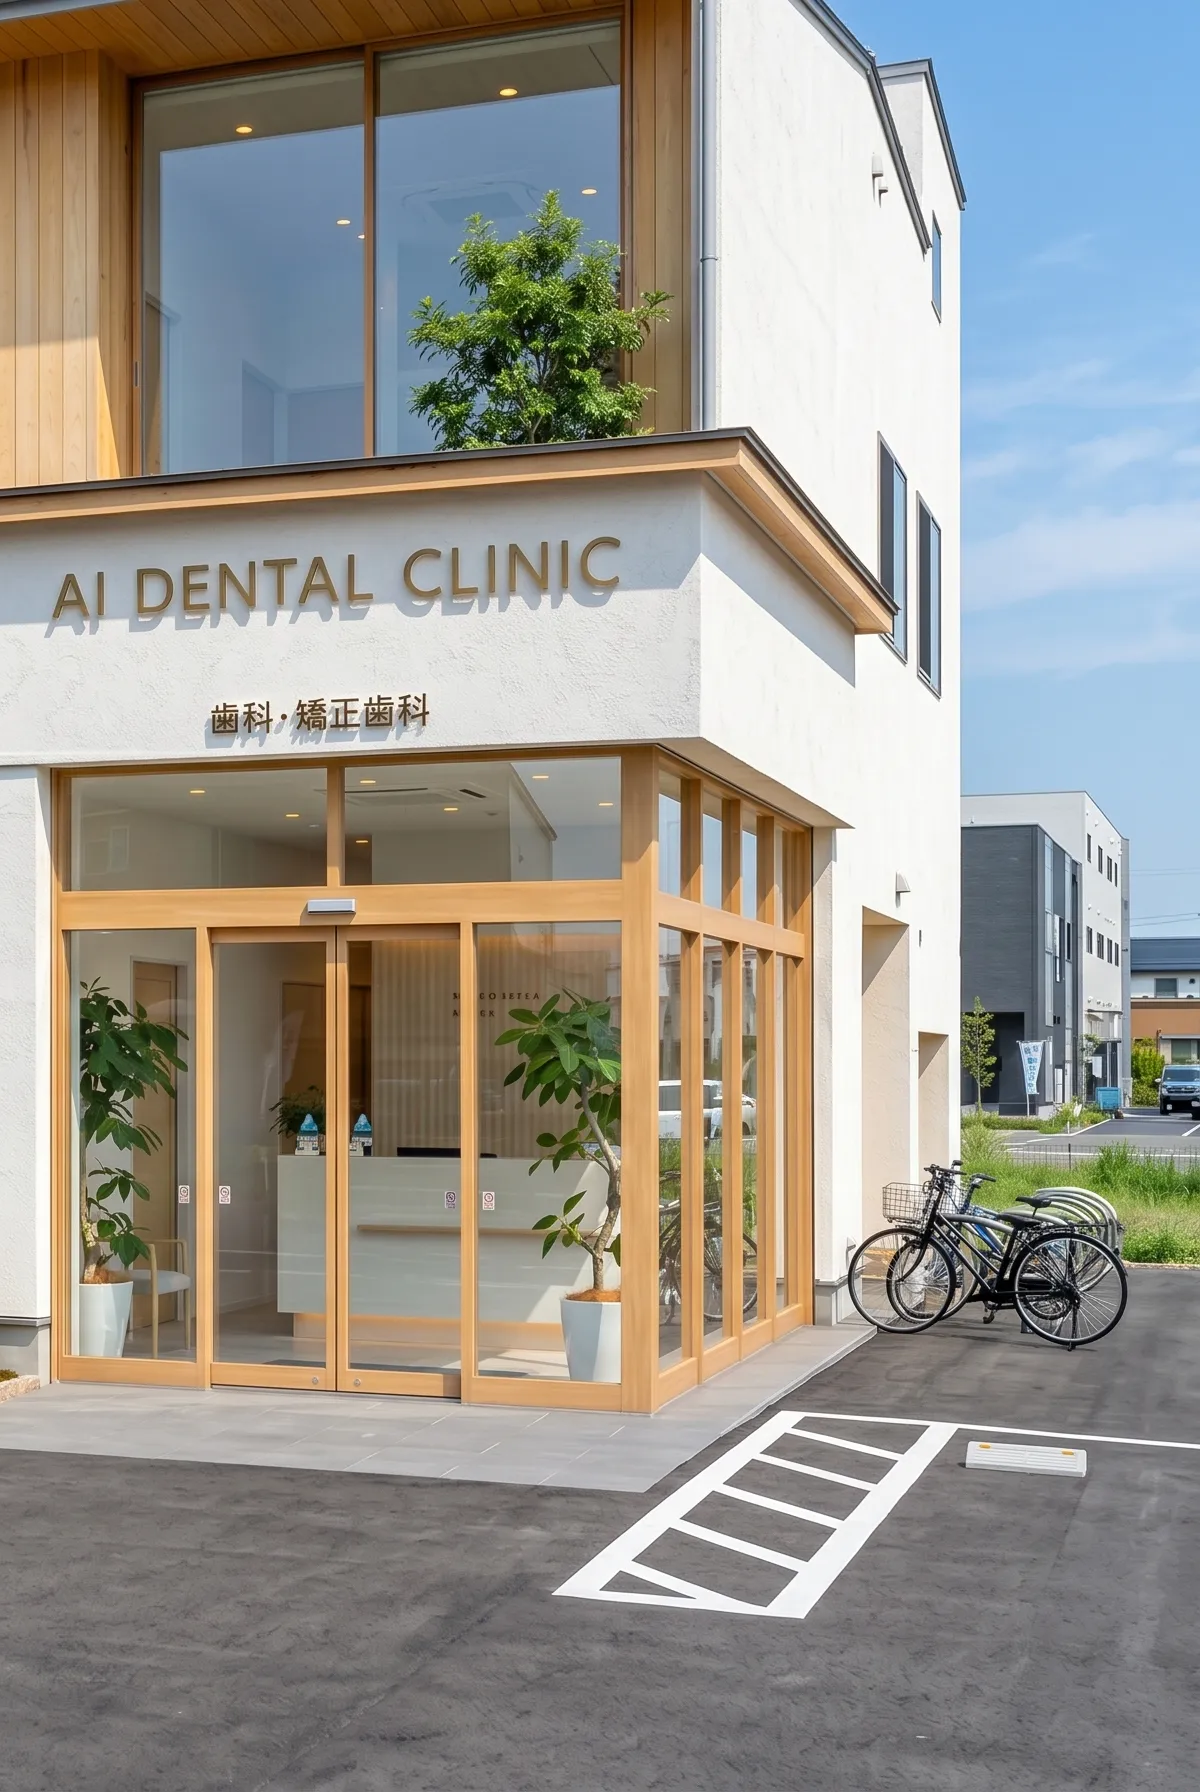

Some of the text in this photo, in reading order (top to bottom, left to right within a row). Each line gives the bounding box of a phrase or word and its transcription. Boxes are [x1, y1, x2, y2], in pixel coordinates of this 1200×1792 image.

[52, 536, 621, 619] AI DENTAL CLINIC
[211, 693, 430, 734] 歯科・矯正歯科
